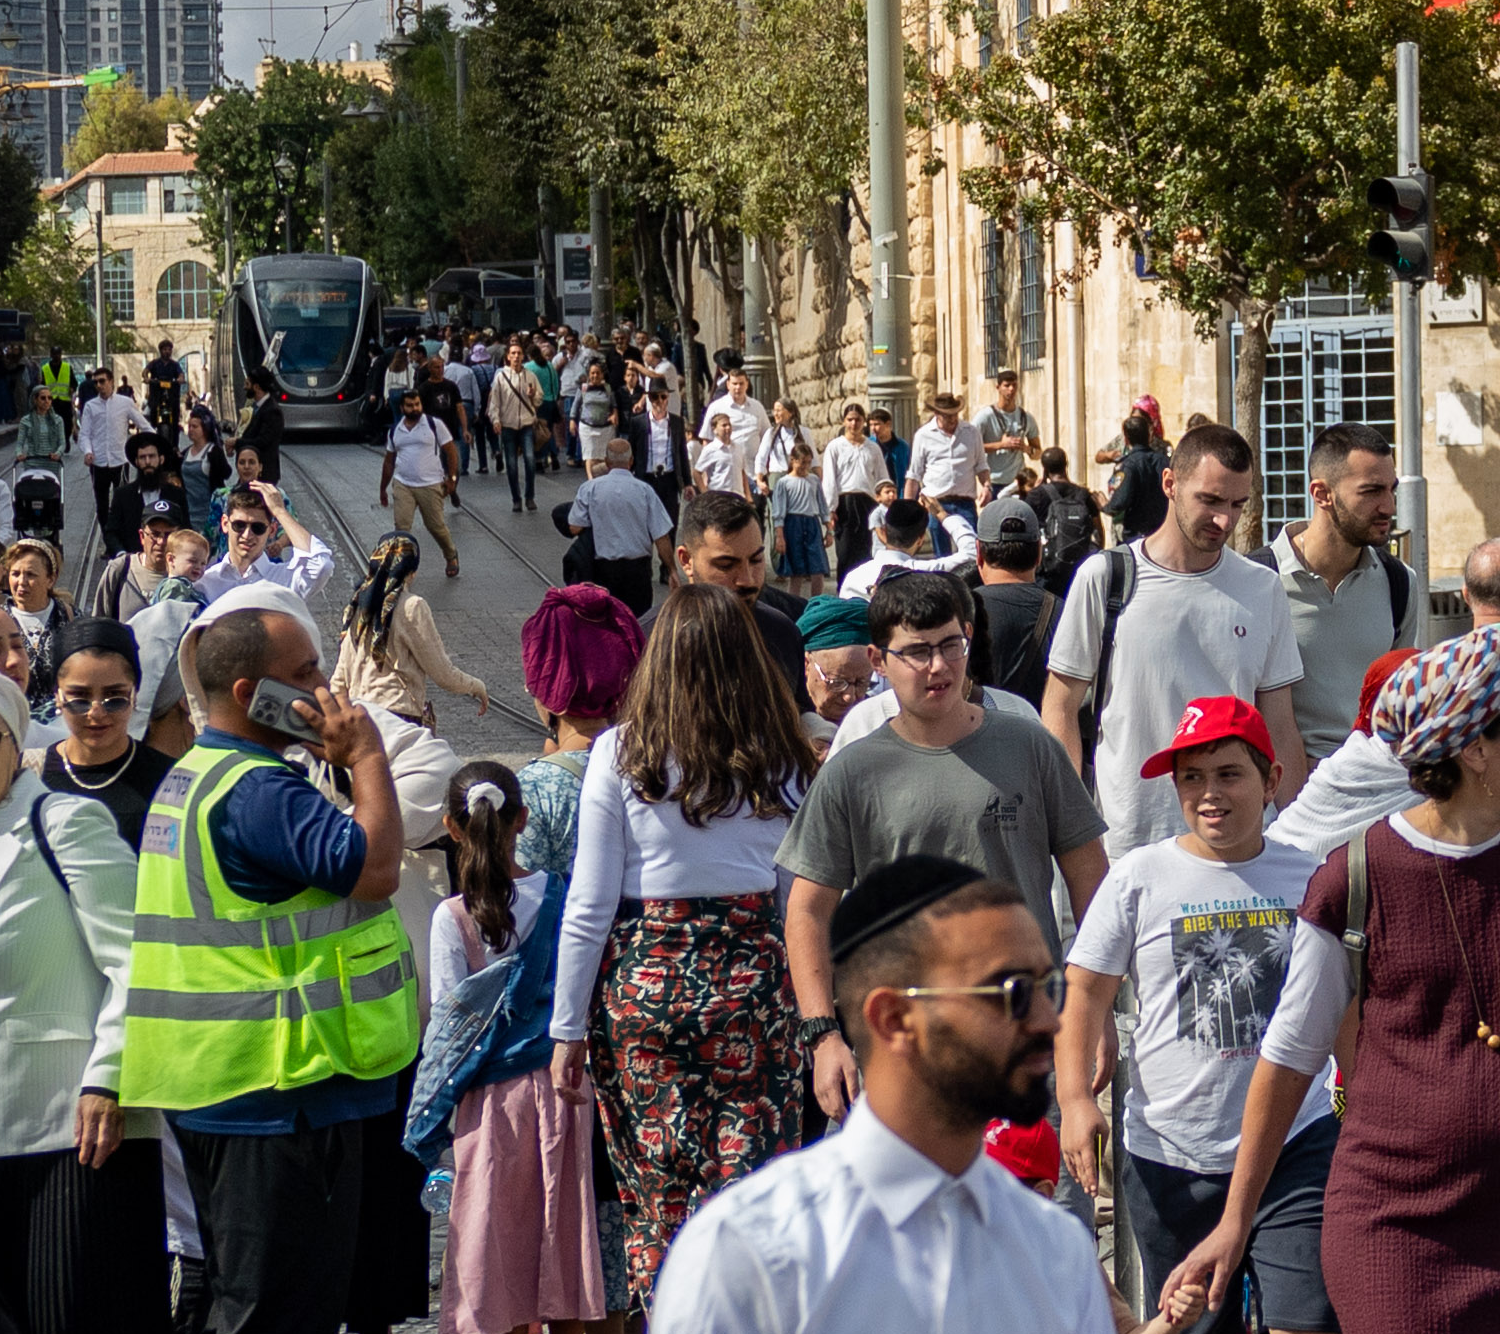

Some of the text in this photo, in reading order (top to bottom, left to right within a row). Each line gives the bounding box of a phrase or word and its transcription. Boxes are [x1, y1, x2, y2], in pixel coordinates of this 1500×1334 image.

[1181, 896, 1286, 914] West Coast Beach
[1183, 909, 1290, 934] RIDE THE WAVES
